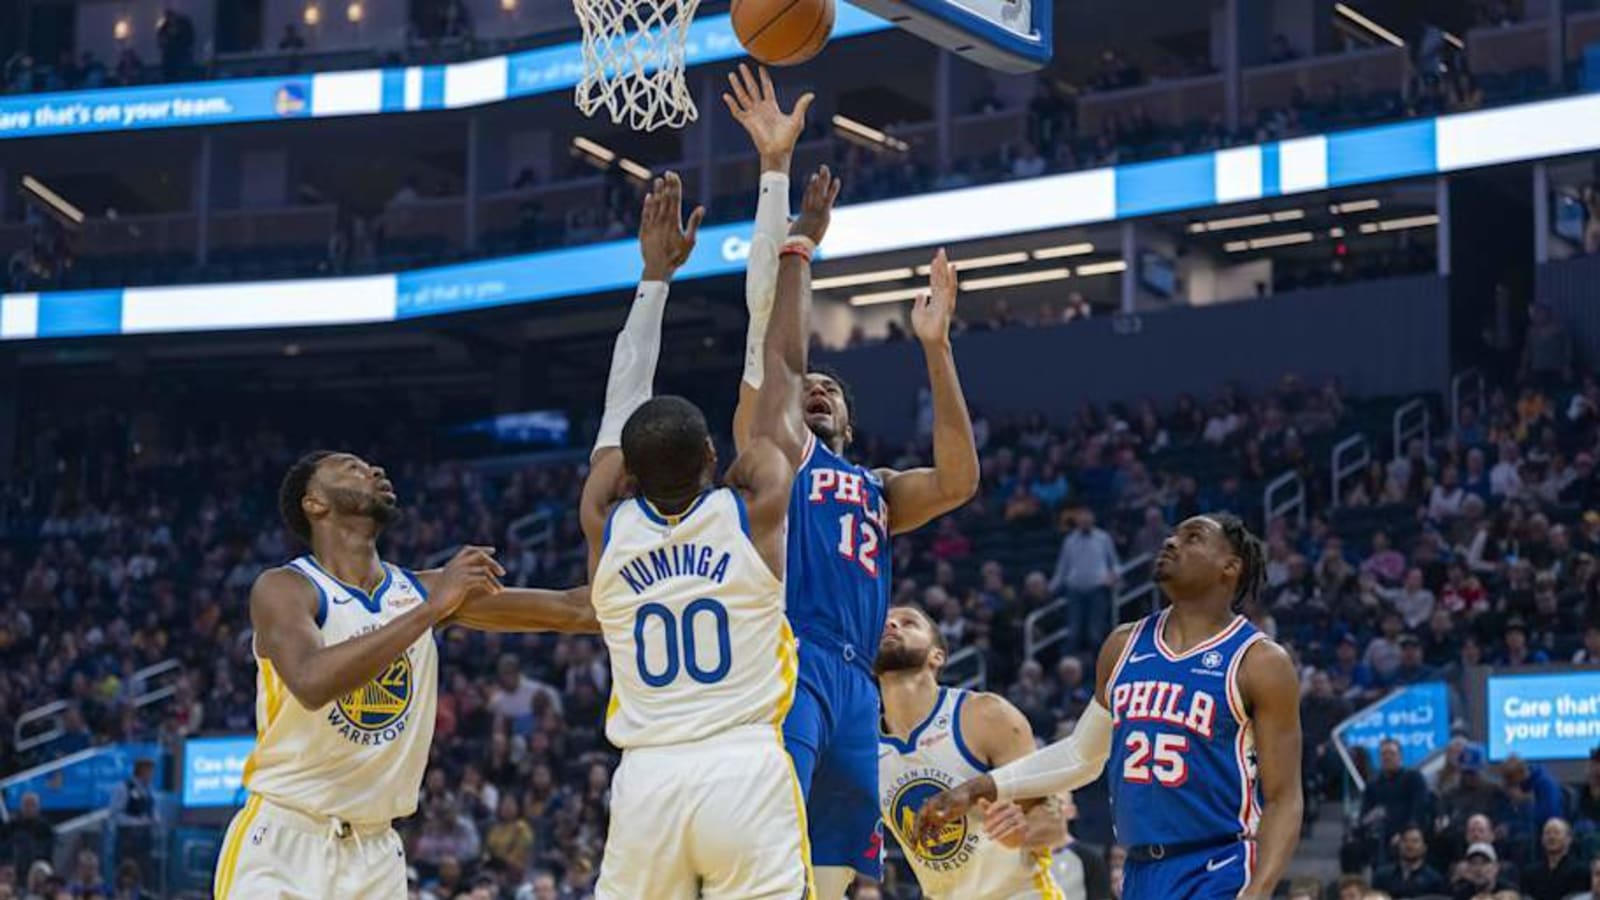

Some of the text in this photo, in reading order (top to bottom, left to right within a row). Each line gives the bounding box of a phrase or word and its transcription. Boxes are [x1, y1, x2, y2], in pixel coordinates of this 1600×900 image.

[35, 103, 91, 126] that's
[93, 104, 120, 123] on
[123, 101, 170, 126] your
[721, 235, 751, 262] Ca
[838, 513, 879, 579] 12
[619, 543, 731, 595] KUMINGA
[633, 598, 732, 687] 00
[328, 706, 409, 746] WARRIOR
[1113, 680, 1217, 740] PHILA
[1503, 696, 1552, 718] Care
[1503, 722, 1551, 745] your
[923, 767, 955, 785] STATE
[1123, 731, 1189, 788] 25
